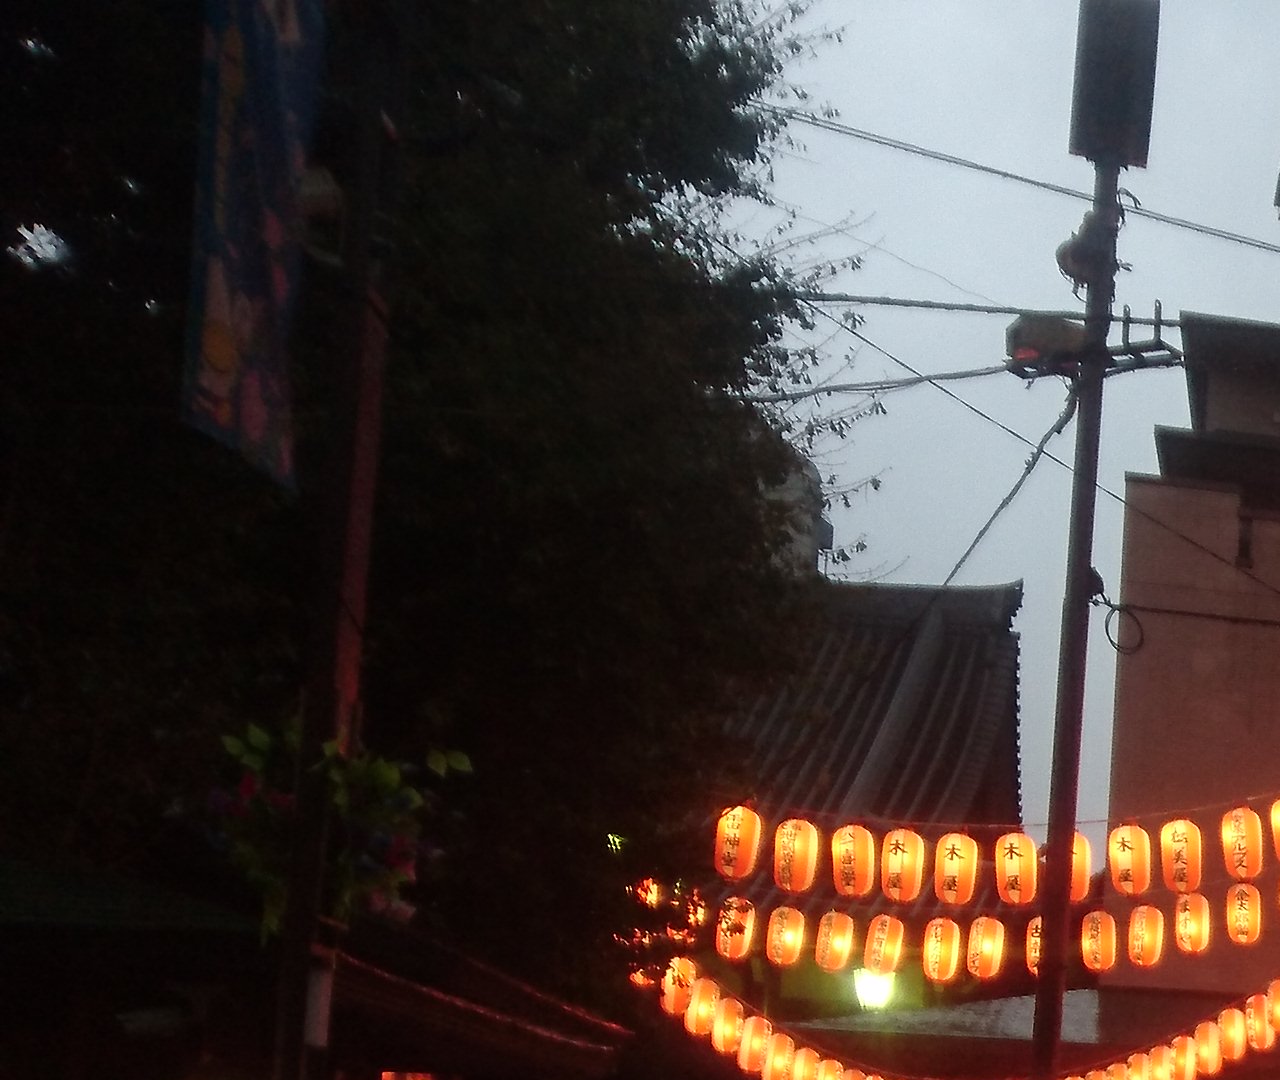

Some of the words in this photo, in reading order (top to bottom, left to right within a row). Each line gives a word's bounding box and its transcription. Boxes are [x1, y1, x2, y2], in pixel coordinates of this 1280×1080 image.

[942, 843, 965, 892] 木屋
[1002, 842, 1024, 891] 木屋
[1116, 837, 1135, 883] 木屋
